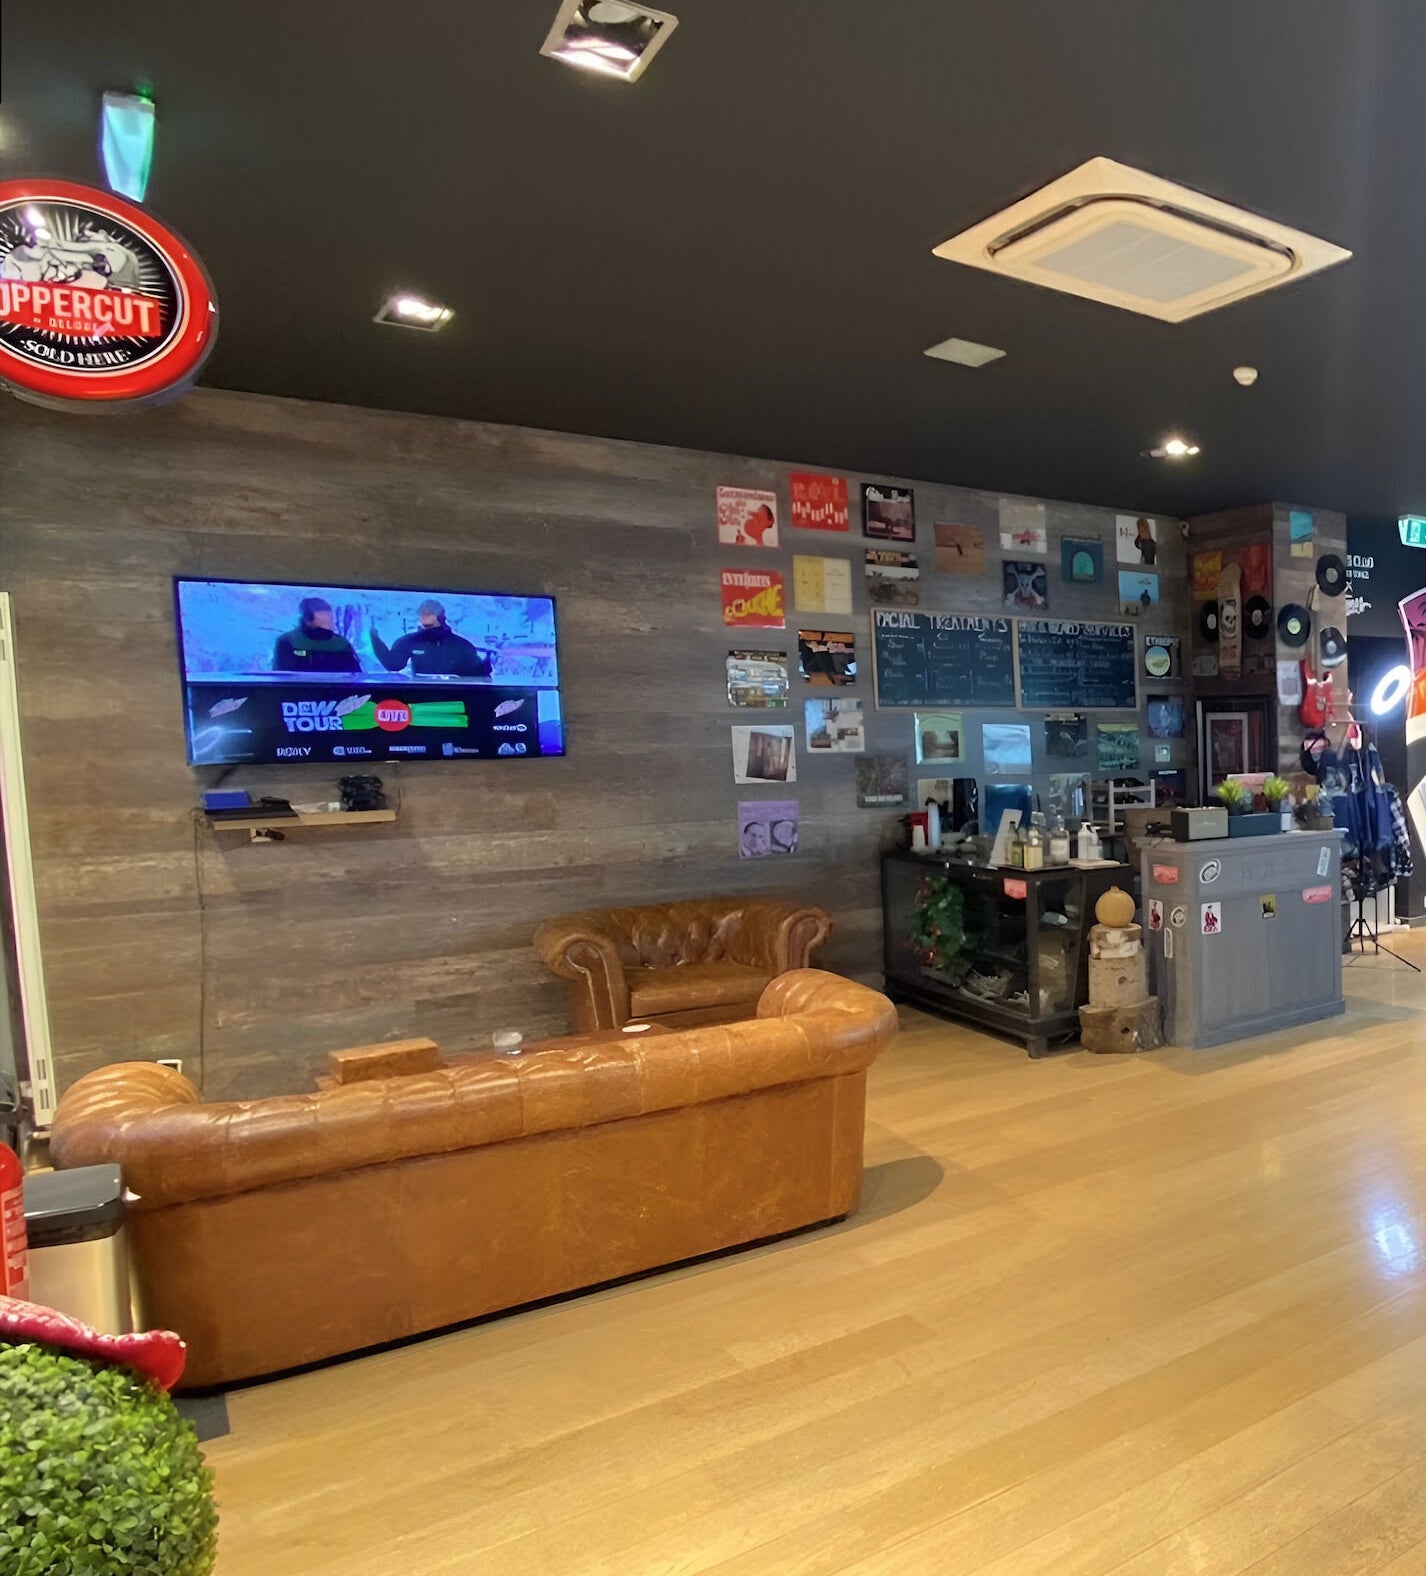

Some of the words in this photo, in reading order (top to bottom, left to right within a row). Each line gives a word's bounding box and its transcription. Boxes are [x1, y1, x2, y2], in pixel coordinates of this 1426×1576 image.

[24, 339, 75, 364] SOLD
[77, 349, 130, 366] HERE
[282, 701, 337, 716] DEW
[283, 716, 344, 733] TOUR
